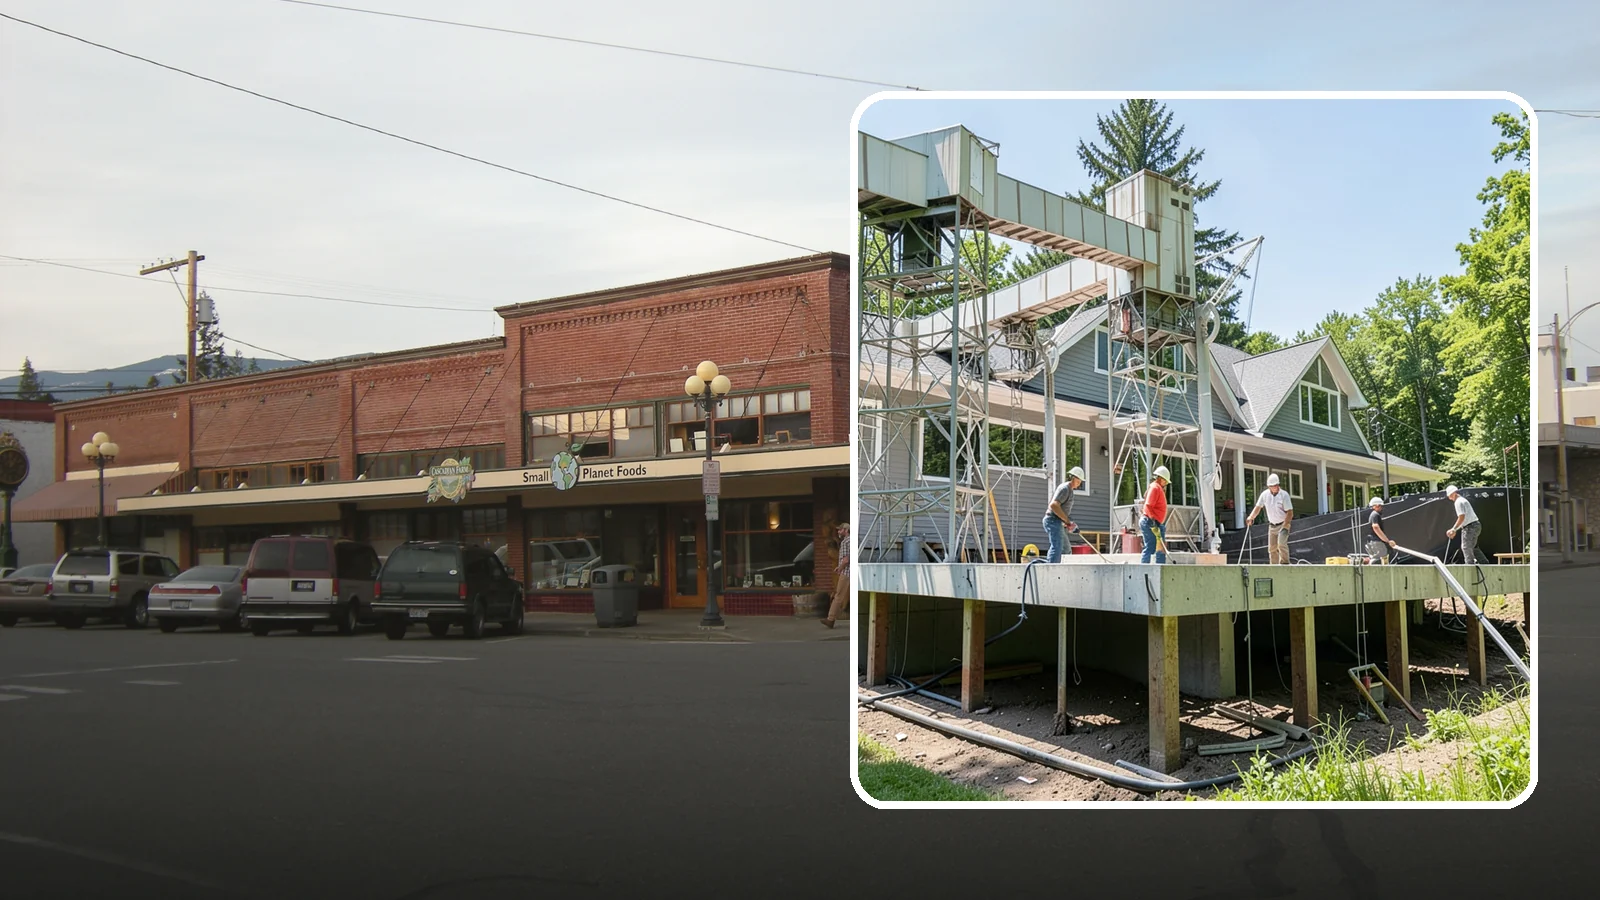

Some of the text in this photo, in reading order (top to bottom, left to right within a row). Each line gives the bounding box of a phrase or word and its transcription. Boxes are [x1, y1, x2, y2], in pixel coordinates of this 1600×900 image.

[523, 464, 647, 483] Small Planet Foods
